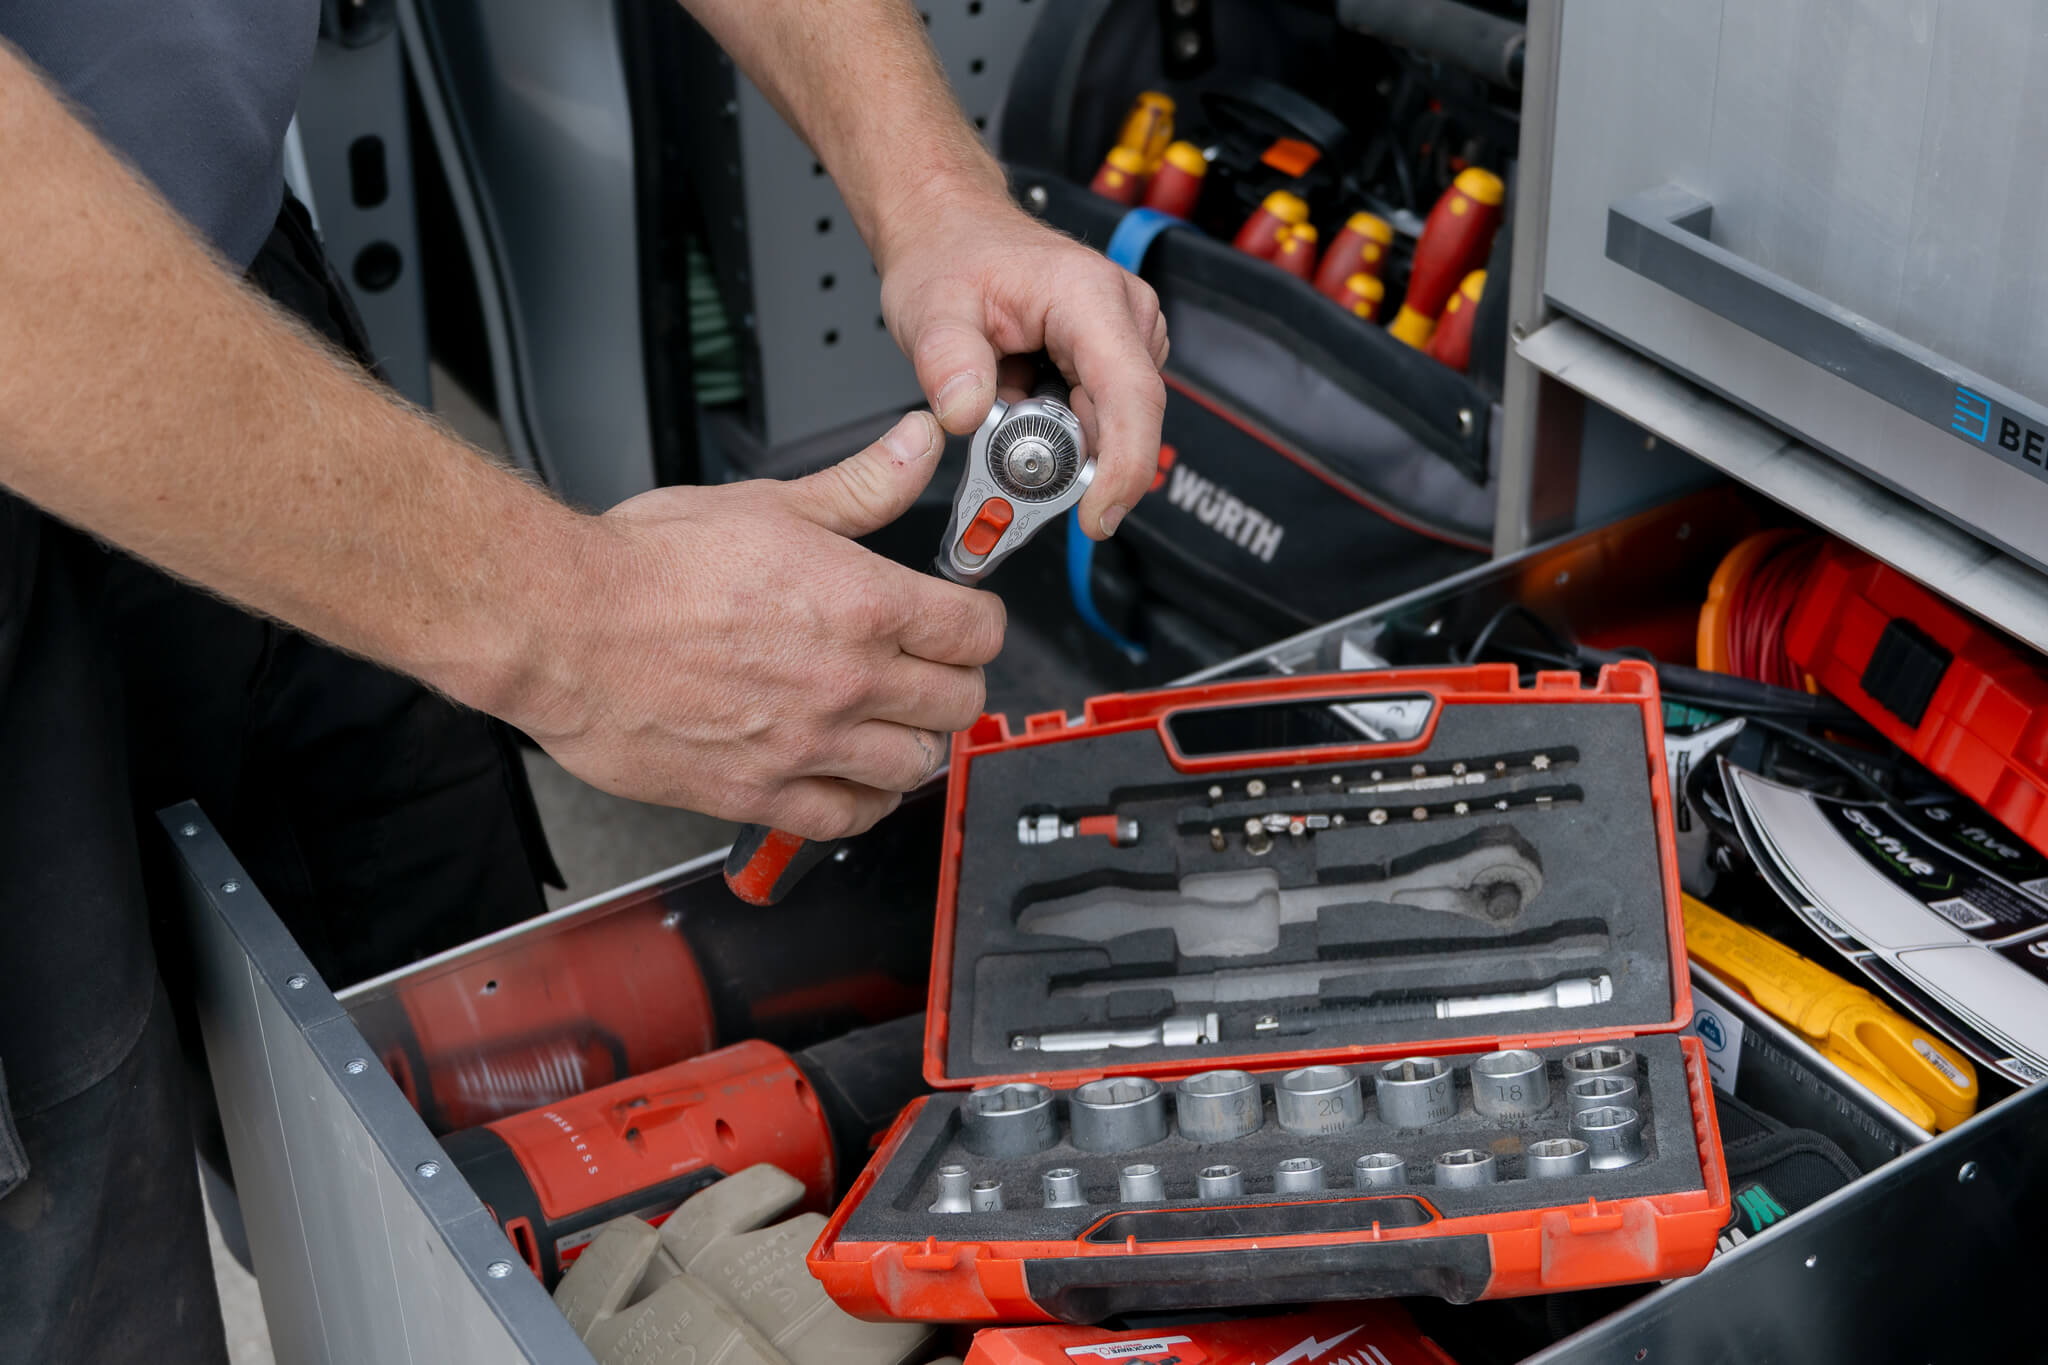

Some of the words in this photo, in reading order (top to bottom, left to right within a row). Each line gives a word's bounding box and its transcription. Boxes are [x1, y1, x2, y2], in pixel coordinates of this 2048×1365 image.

[1998, 415, 2048, 470] BE
[1168, 463, 1284, 563] WÜRTH
[1425, 1082, 1446, 1103] 19
[1496, 1084, 1522, 1101] 18
[1318, 1096, 1344, 1117] 20
[1048, 1188, 1058, 1202] 8
[984, 1201, 995, 1213] 7
